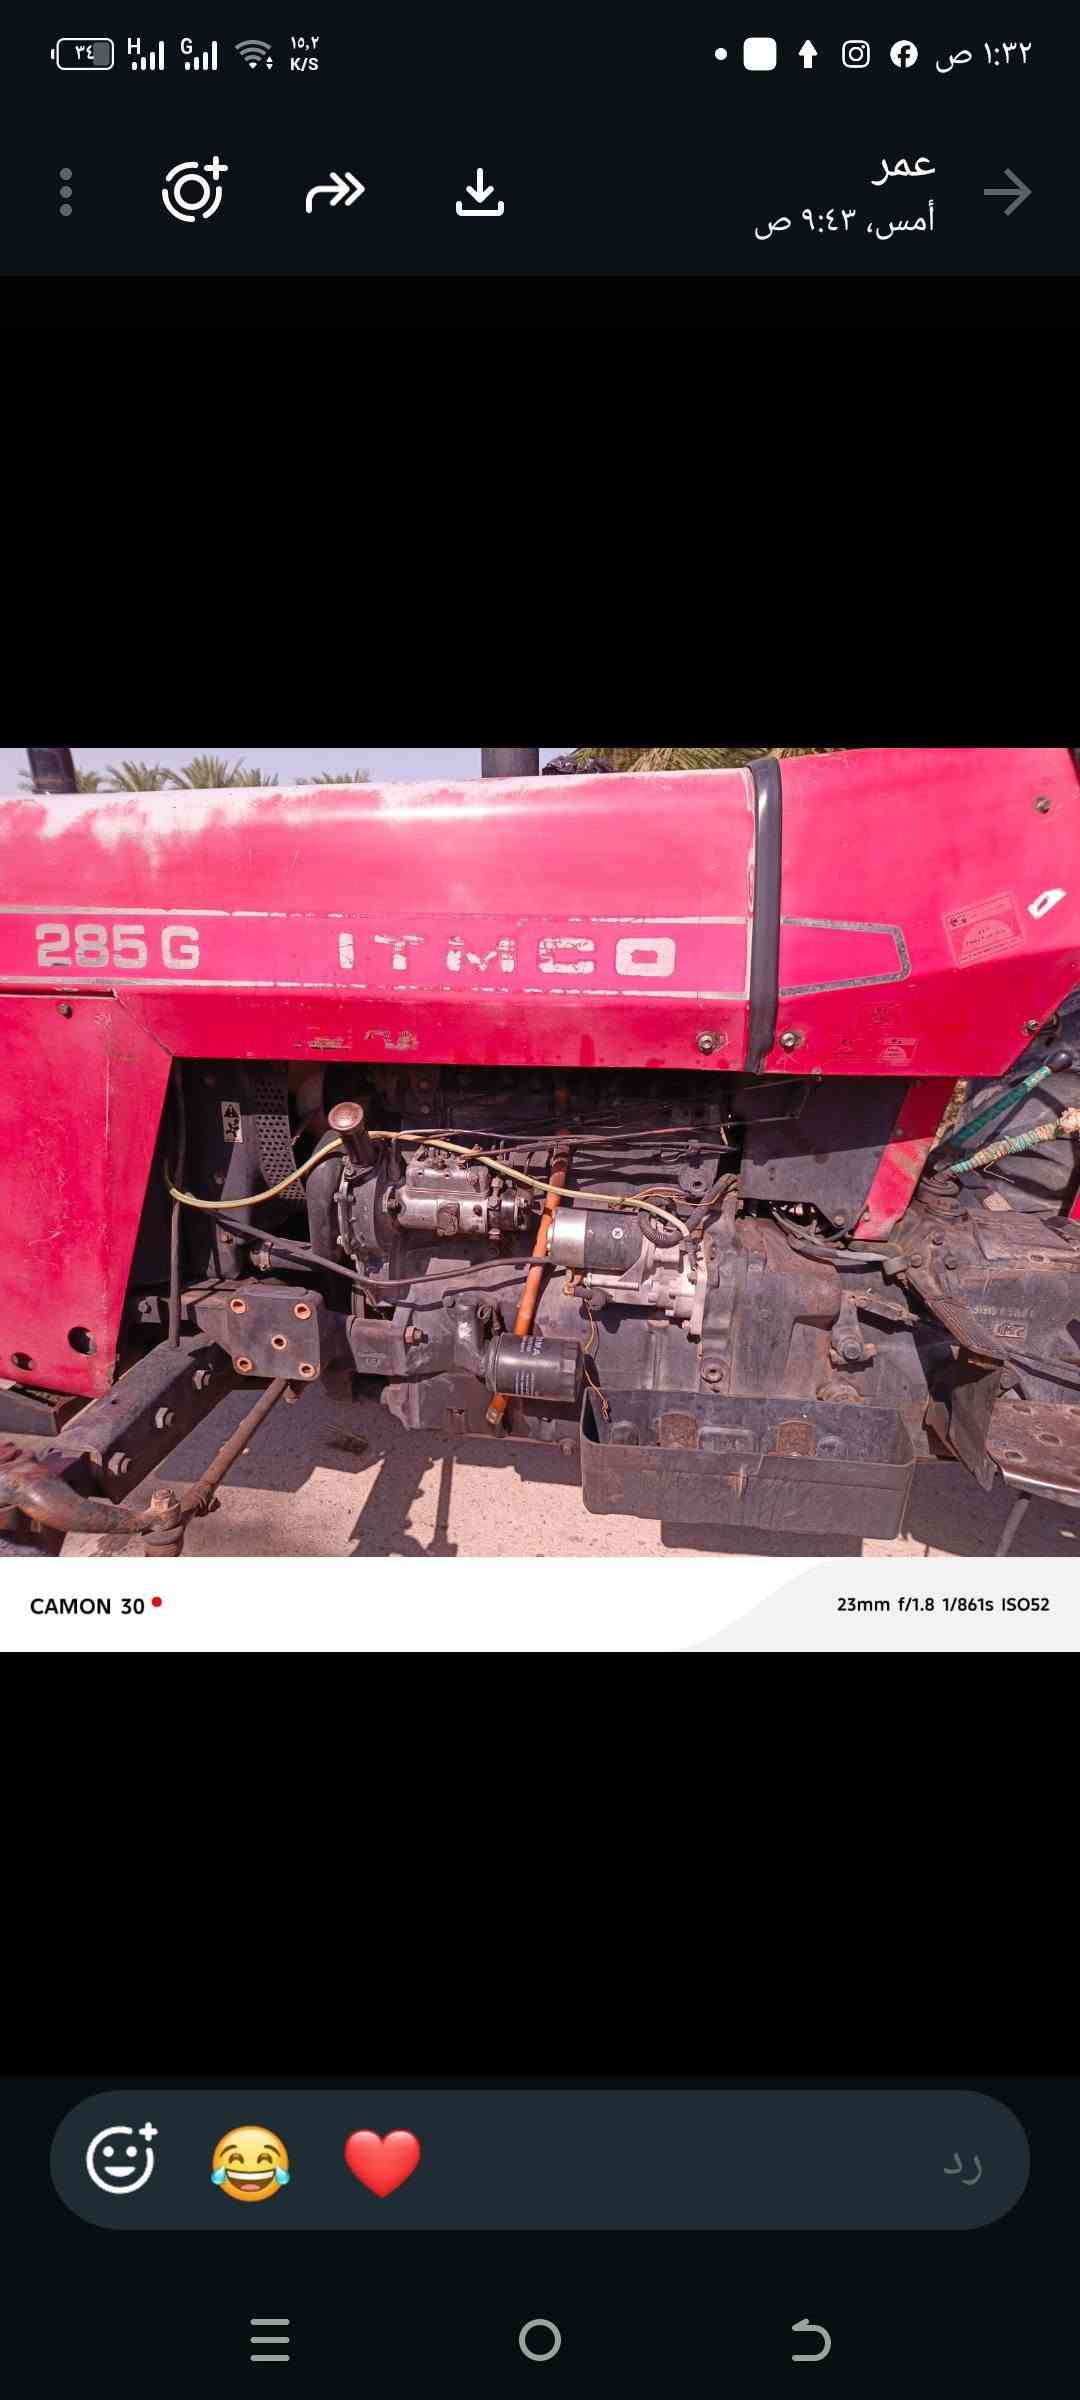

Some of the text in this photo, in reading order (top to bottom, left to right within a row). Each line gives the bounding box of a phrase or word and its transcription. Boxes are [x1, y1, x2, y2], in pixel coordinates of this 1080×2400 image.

[127, 37, 141, 55] H
[180, 37, 193, 55] G
[935, 41, 1032, 74] ١:٣٢ ص
[290, 57, 319, 72] K/S
[871, 153, 936, 186] عمر
[754, 216, 792, 241] ص
[801, 208, 856, 233] ٩:٤٣
[943, 2152, 982, 2185] رد
